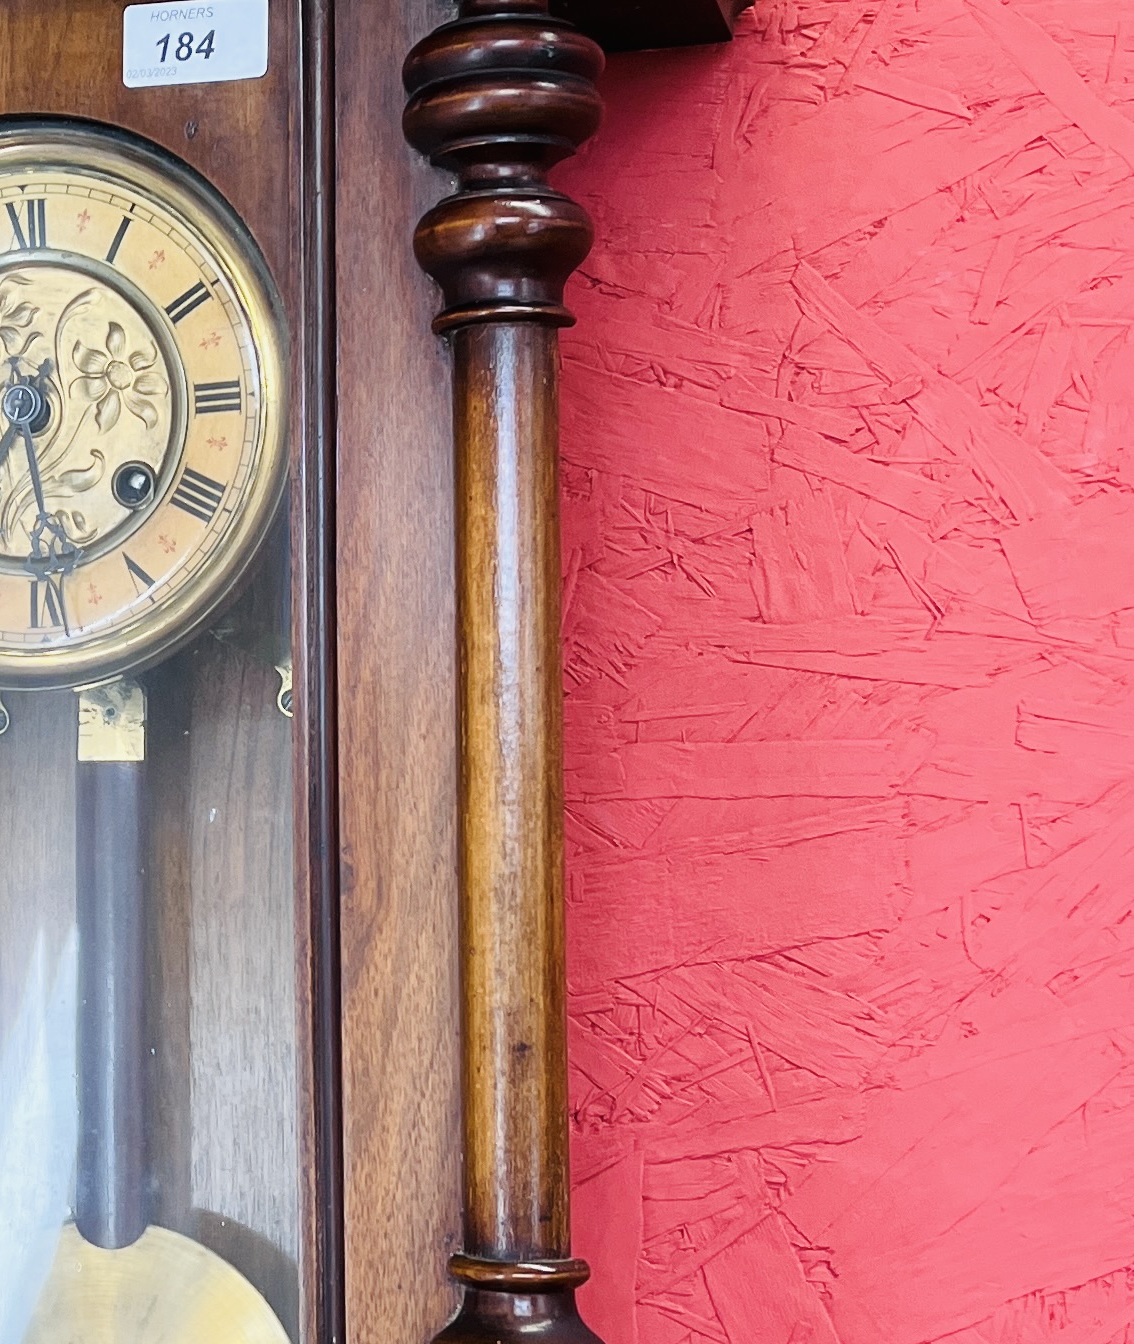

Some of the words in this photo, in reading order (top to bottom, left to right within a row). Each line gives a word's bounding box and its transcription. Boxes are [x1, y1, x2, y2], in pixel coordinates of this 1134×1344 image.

[150, 7, 214, 22] HORNERS
[156, 29, 216, 63] 184
[126, 67, 177, 80] 02/03/2023
[4, 198, 47, 251] XII
[104, 214, 134, 265] I
[161, 278, 214, 328] II
[193, 376, 242, 419] III
[168, 462, 229, 528] IIII
